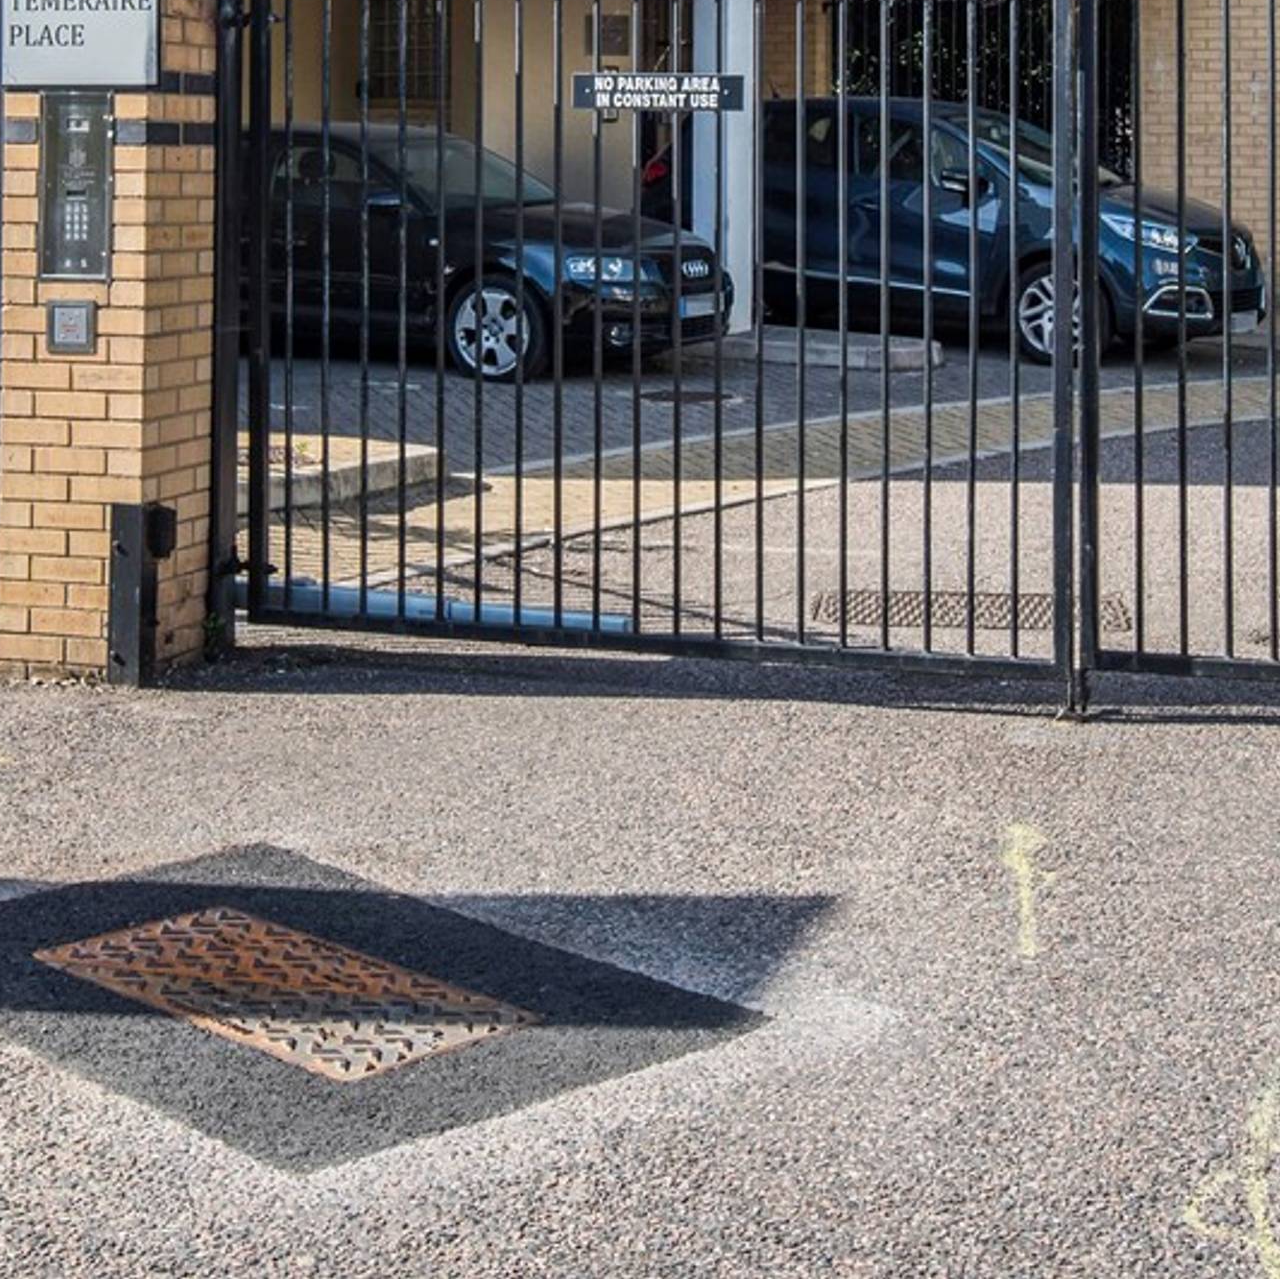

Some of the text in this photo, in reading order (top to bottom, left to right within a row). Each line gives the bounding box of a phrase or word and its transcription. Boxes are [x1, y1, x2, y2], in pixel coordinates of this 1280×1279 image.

[8, 24, 86, 48] PLACE
[593, 76, 720, 92] NO PARKING AREA
[595, 93, 718, 108] IN CONSTANT USE
